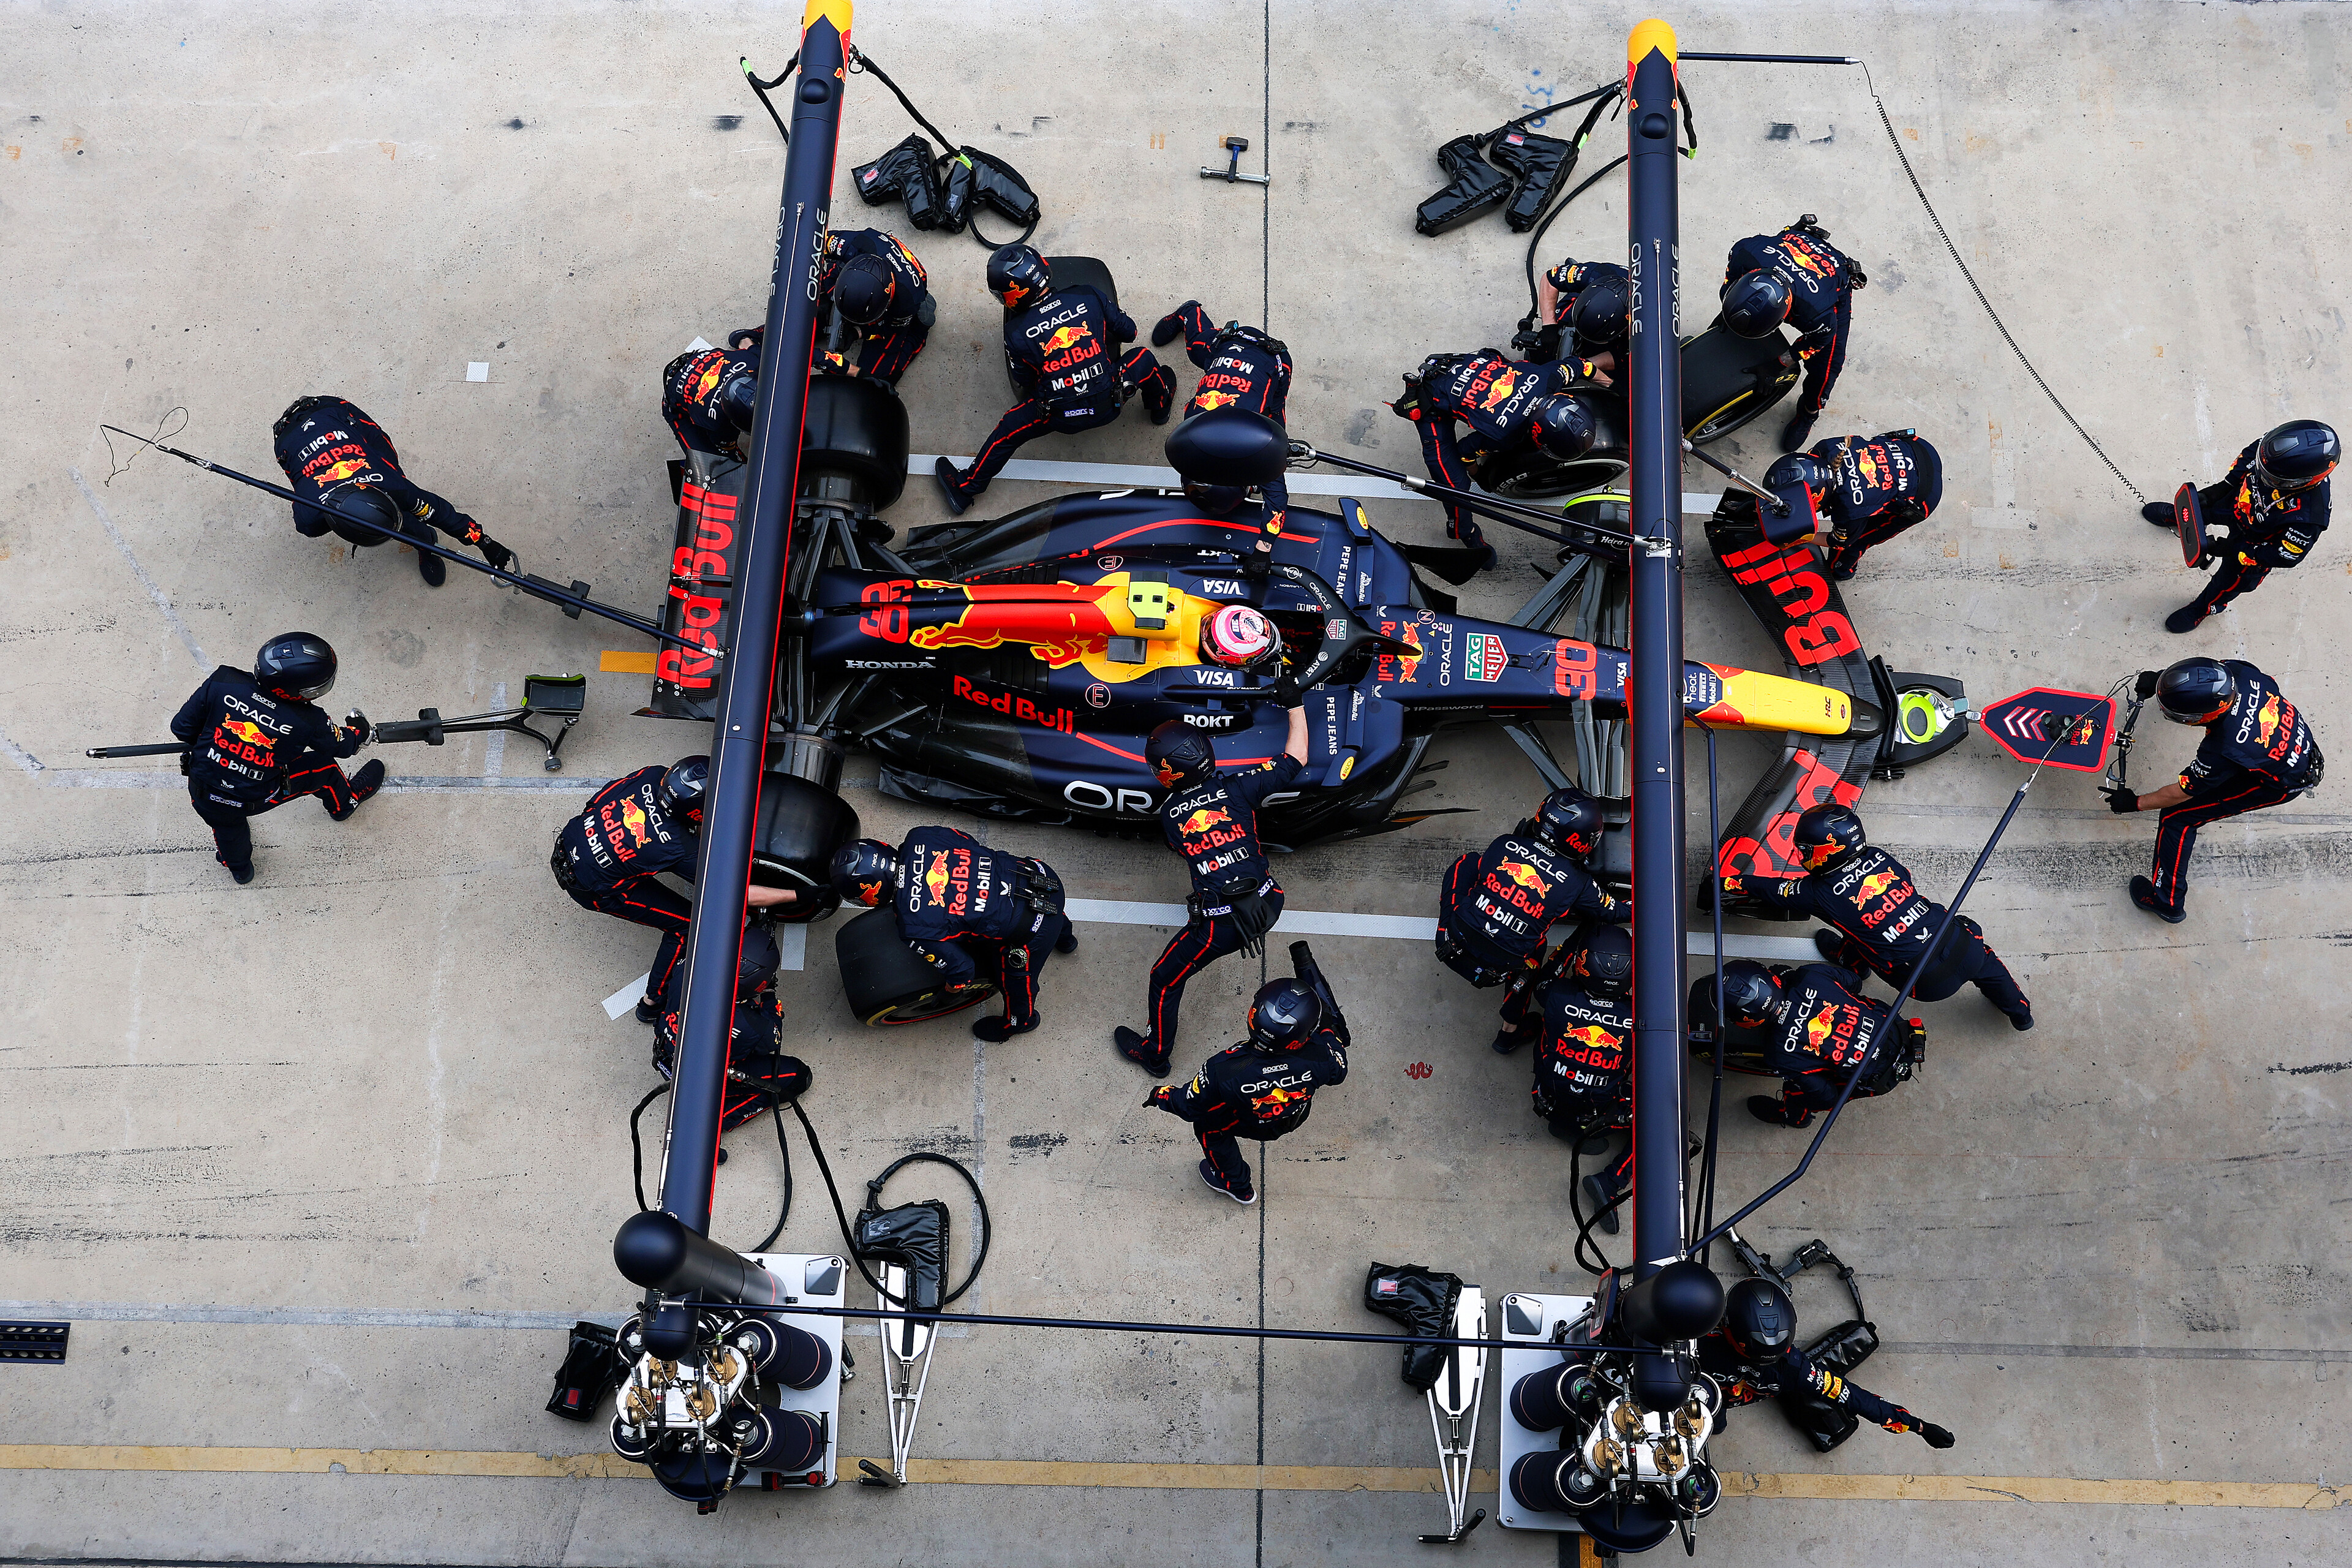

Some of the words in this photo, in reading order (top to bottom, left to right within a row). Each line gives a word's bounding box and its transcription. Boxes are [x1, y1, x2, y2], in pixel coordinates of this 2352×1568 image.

[807, 207, 826, 301] ORACLE
[1782, 233, 1812, 254] Bull
[1577, 266, 1588, 281] Mobil
[1762, 246, 1819, 293] ORACLE
[1809, 254, 1836, 277] Red
[1631, 242, 1643, 336] ORACLE
[1025, 304, 1088, 339] ORACLE
[1039, 300, 1061, 313] sparco
[681, 352, 710, 379] Mobil
[695, 351, 725, 374] Red
[1042, 347, 1070, 374] Red
[1072, 338, 1102, 364] Bull
[1218, 357, 1254, 374] Mobil
[1458, 358, 1489, 383] Mobil
[1479, 356, 1507, 382] Red
[684, 373, 700, 405] Bull
[1052, 368, 1090, 391] Mobil
[1217, 374, 1252, 393] Red
[1461, 379, 1489, 409] Bull
[1496, 374, 1539, 428] ORACLE
[309, 431, 349, 450] Mobil
[331, 444, 366, 461] Red
[1869, 444, 1888, 466] Bull
[302, 453, 331, 477] Bull
[1880, 468, 1894, 491] Red
[1894, 453, 1907, 491] Mobil
[672, 483, 737, 584] Bull
[2285, 531, 2310, 546] ROKT
[1340, 546, 1351, 570] PEPE
[1203, 579, 1244, 595] VISA
[1309, 582, 1332, 610] ORACLE
[1721, 540, 1861, 666] Bull
[657, 586, 722, 688] Red
[859, 603, 910, 644] 30
[845, 660, 937, 669] HONDA
[1305, 660, 1321, 678] AT&T
[1378, 654, 1394, 682] Bull
[1440, 623, 1453, 687] ORACLE
[1470, 638, 1481, 676] TAG
[1486, 637, 1499, 680] HEUER
[1555, 639, 1597, 701] 30
[1193, 670, 1234, 687] VISA
[1616, 662, 1627, 689] VISA
[251, 692, 277, 709] sparco
[954, 675, 1010, 714] Red
[1016, 697, 1073, 734] Bull
[1093, 687, 1104, 705] E
[1326, 696, 1336, 722] PEPE
[224, 694, 293, 735] ORACLE
[1184, 714, 1234, 728] ROKT
[2236, 679, 2261, 744] ORACLE
[1327, 724, 1338, 755] JEANS
[2268, 725, 2291, 761] Red
[2281, 699, 2296, 729] Bull
[207, 748, 246, 775] Mobil
[213, 727, 242, 754] Red
[239, 746, 274, 767] Bull
[2286, 728, 2305, 767] Mobil
[1343, 759, 1352, 774] RAUCH
[209, 794, 243, 808] sparco
[641, 783, 671, 844] ORACLE
[1169, 789, 1228, 818] ORACLE
[600, 801, 621, 832] Red
[584, 815, 604, 855] Mobil
[609, 828, 637, 863] Bull
[1183, 834, 1213, 856] Red
[1209, 824, 1246, 848] Bull
[1533, 842, 1556, 857] sparco
[954, 848, 971, 879] Bull
[980, 858, 992, 870] 1
[1197, 853, 1235, 875] Mobil
[1505, 840, 1568, 883] ORACLE
[1833, 852, 1886, 896] ORACLE
[910, 843, 925, 913] ORACLE
[974, 871, 991, 912] Mobil
[949, 880, 969, 916] Red
[1476, 894, 1514, 927] Mobil
[1483, 873, 1516, 900] Red
[1512, 884, 1545, 919] Bull
[1860, 901, 1895, 929] Red
[1891, 880, 1914, 907] Bull
[1882, 907, 1920, 943] Mobil
[1564, 1005, 1632, 1028] ORACLE
[1589, 998, 1613, 1007] sparco
[1784, 989, 1817, 1052] ORACLE
[1839, 1005, 1861, 1039] Bull
[1556, 1038, 1589, 1063] Red
[1589, 1049, 1622, 1070] Bull
[1842, 1033, 1870, 1068] Mobil
[1863, 1017, 1874, 1031] 1
[1240, 1071, 1313, 1093] ORACLE
[1262, 1064, 1288, 1074] sparco
[1555, 1061, 1593, 1085] Mobil
